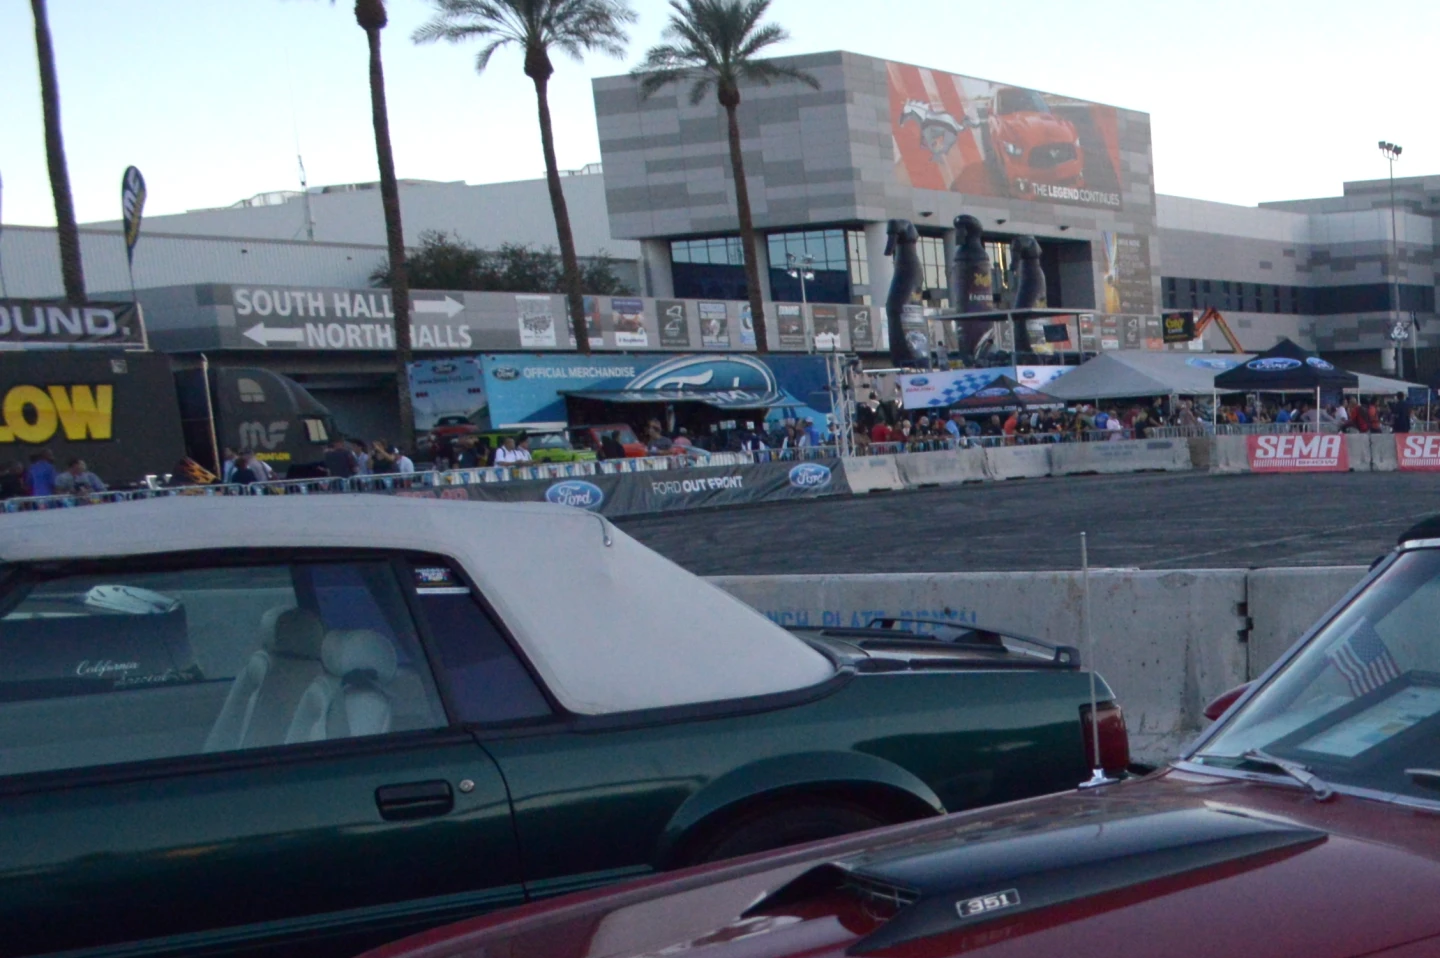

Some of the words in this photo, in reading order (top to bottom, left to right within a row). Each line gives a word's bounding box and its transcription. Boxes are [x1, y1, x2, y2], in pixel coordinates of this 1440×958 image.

[1032, 183, 1047, 197] THE
[1048, 185, 1079, 200] LEGEND
[1080, 189, 1119, 205] CONTINUES
[234, 289, 327, 317] SOUTH
[335, 293, 395, 318] HALL
[305, 322, 396, 348] NORTH
[523, 368, 567, 379] OFFICIAL
[568, 366, 635, 379] MERCHANDISE
[1256, 434, 1342, 458] SEMA
[652, 481, 682, 495] FORD
[682, 479, 706, 493] OUT
[708, 476, 743, 489] FRONT
[76, 659, 138, 676] California
[966, 894, 1011, 914] 351
